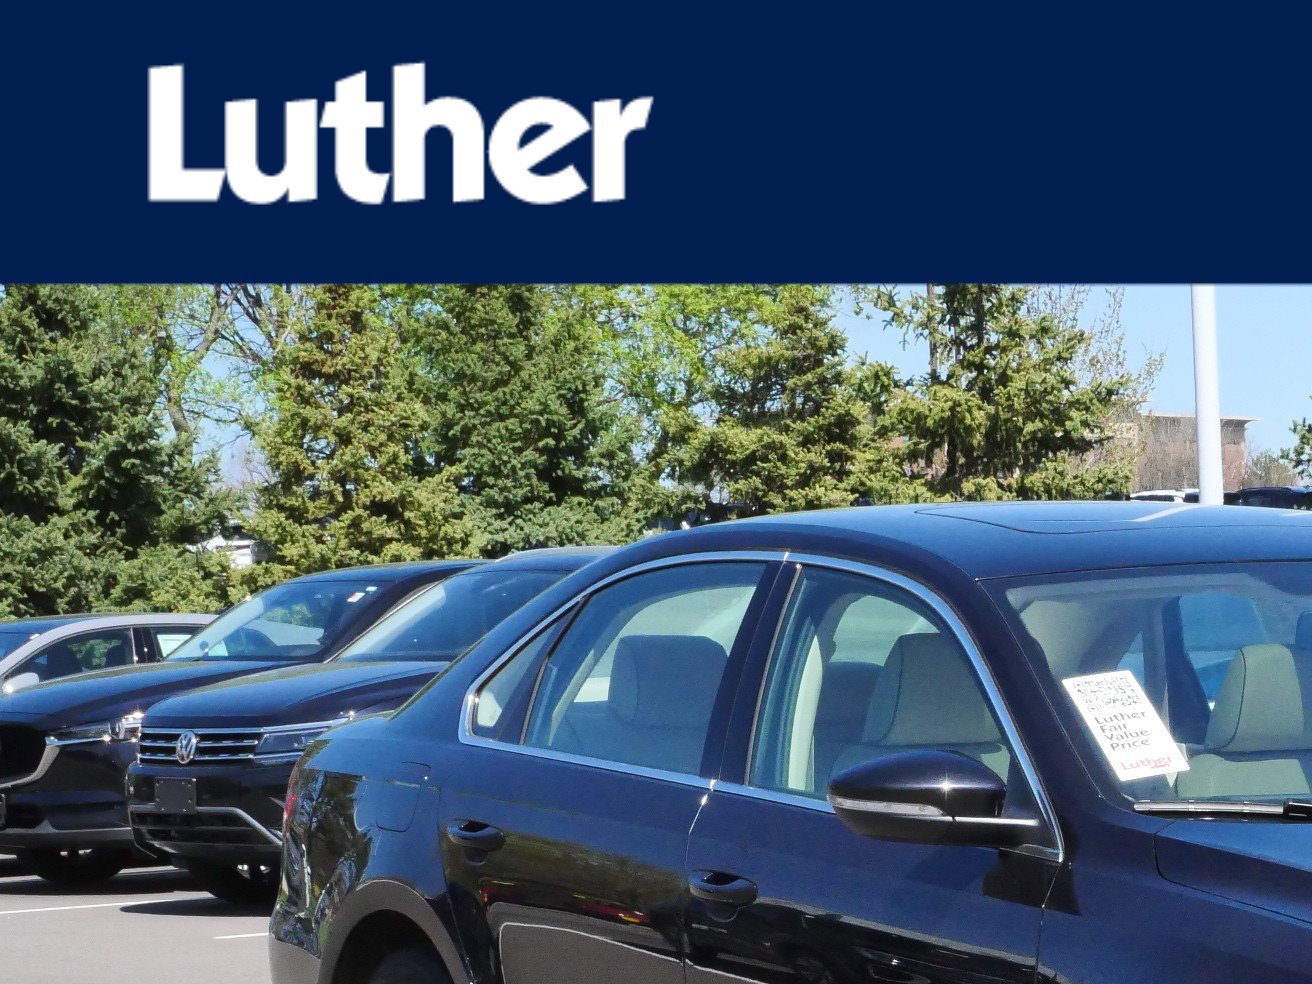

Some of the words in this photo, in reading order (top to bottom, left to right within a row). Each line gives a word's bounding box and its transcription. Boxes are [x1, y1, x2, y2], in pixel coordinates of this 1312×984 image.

[1094, 710, 1146, 725] Luther
[1099, 723, 1128, 734] Fair
[1104, 729, 1150, 741] Value
[1109, 739, 1150, 751] Price
